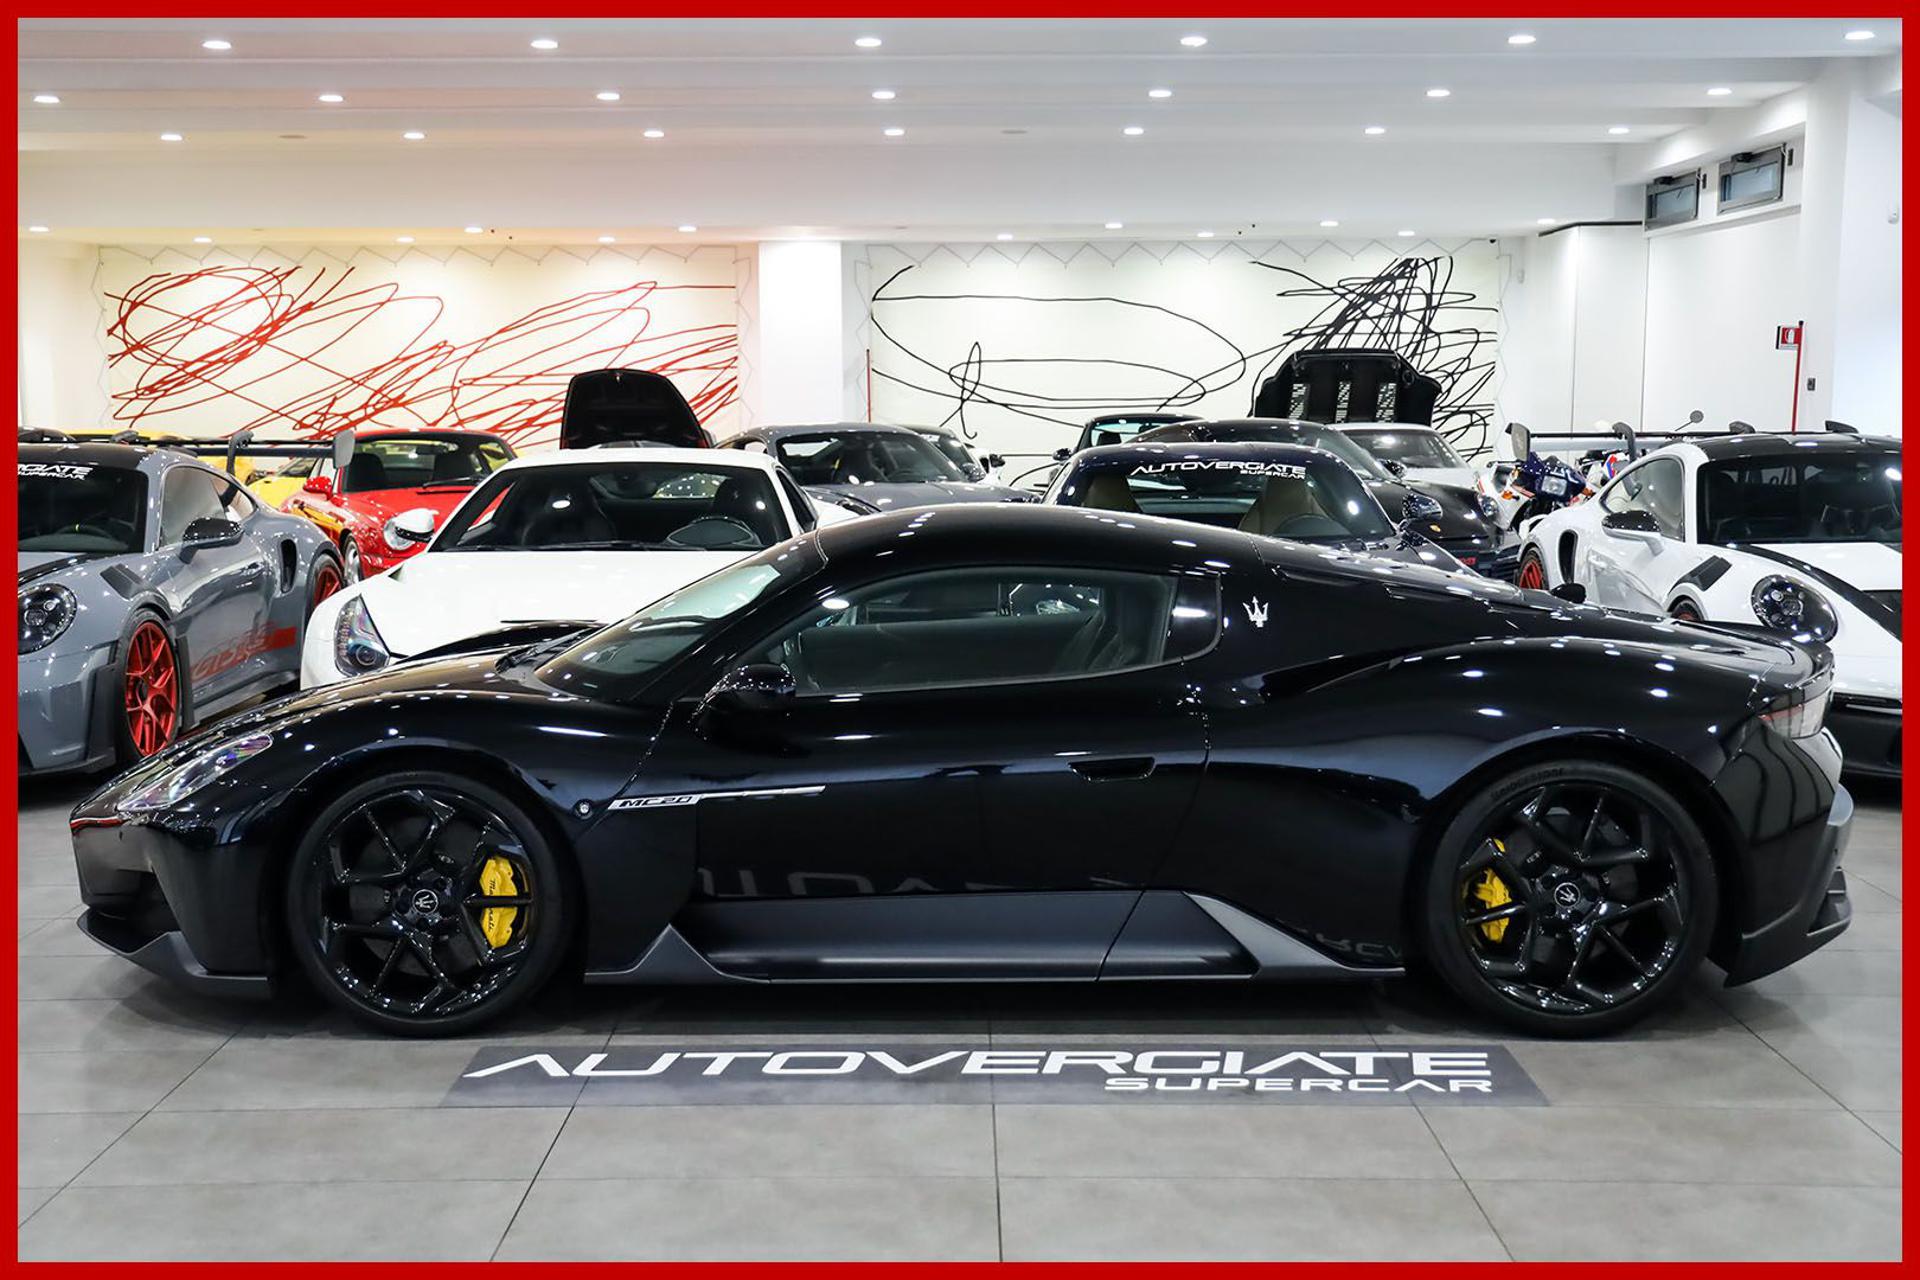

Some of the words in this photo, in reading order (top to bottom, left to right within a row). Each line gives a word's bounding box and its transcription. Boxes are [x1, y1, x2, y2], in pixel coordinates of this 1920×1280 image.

[1130, 461, 1306, 475] AUTOVERGIATE
[1240, 470, 1305, 479] SUPERCAR
[618, 796, 693, 808] MC20
[464, 1050, 1494, 1078] AUTOVERGIATE
[1105, 1077, 1493, 1093] SUPERCAR
